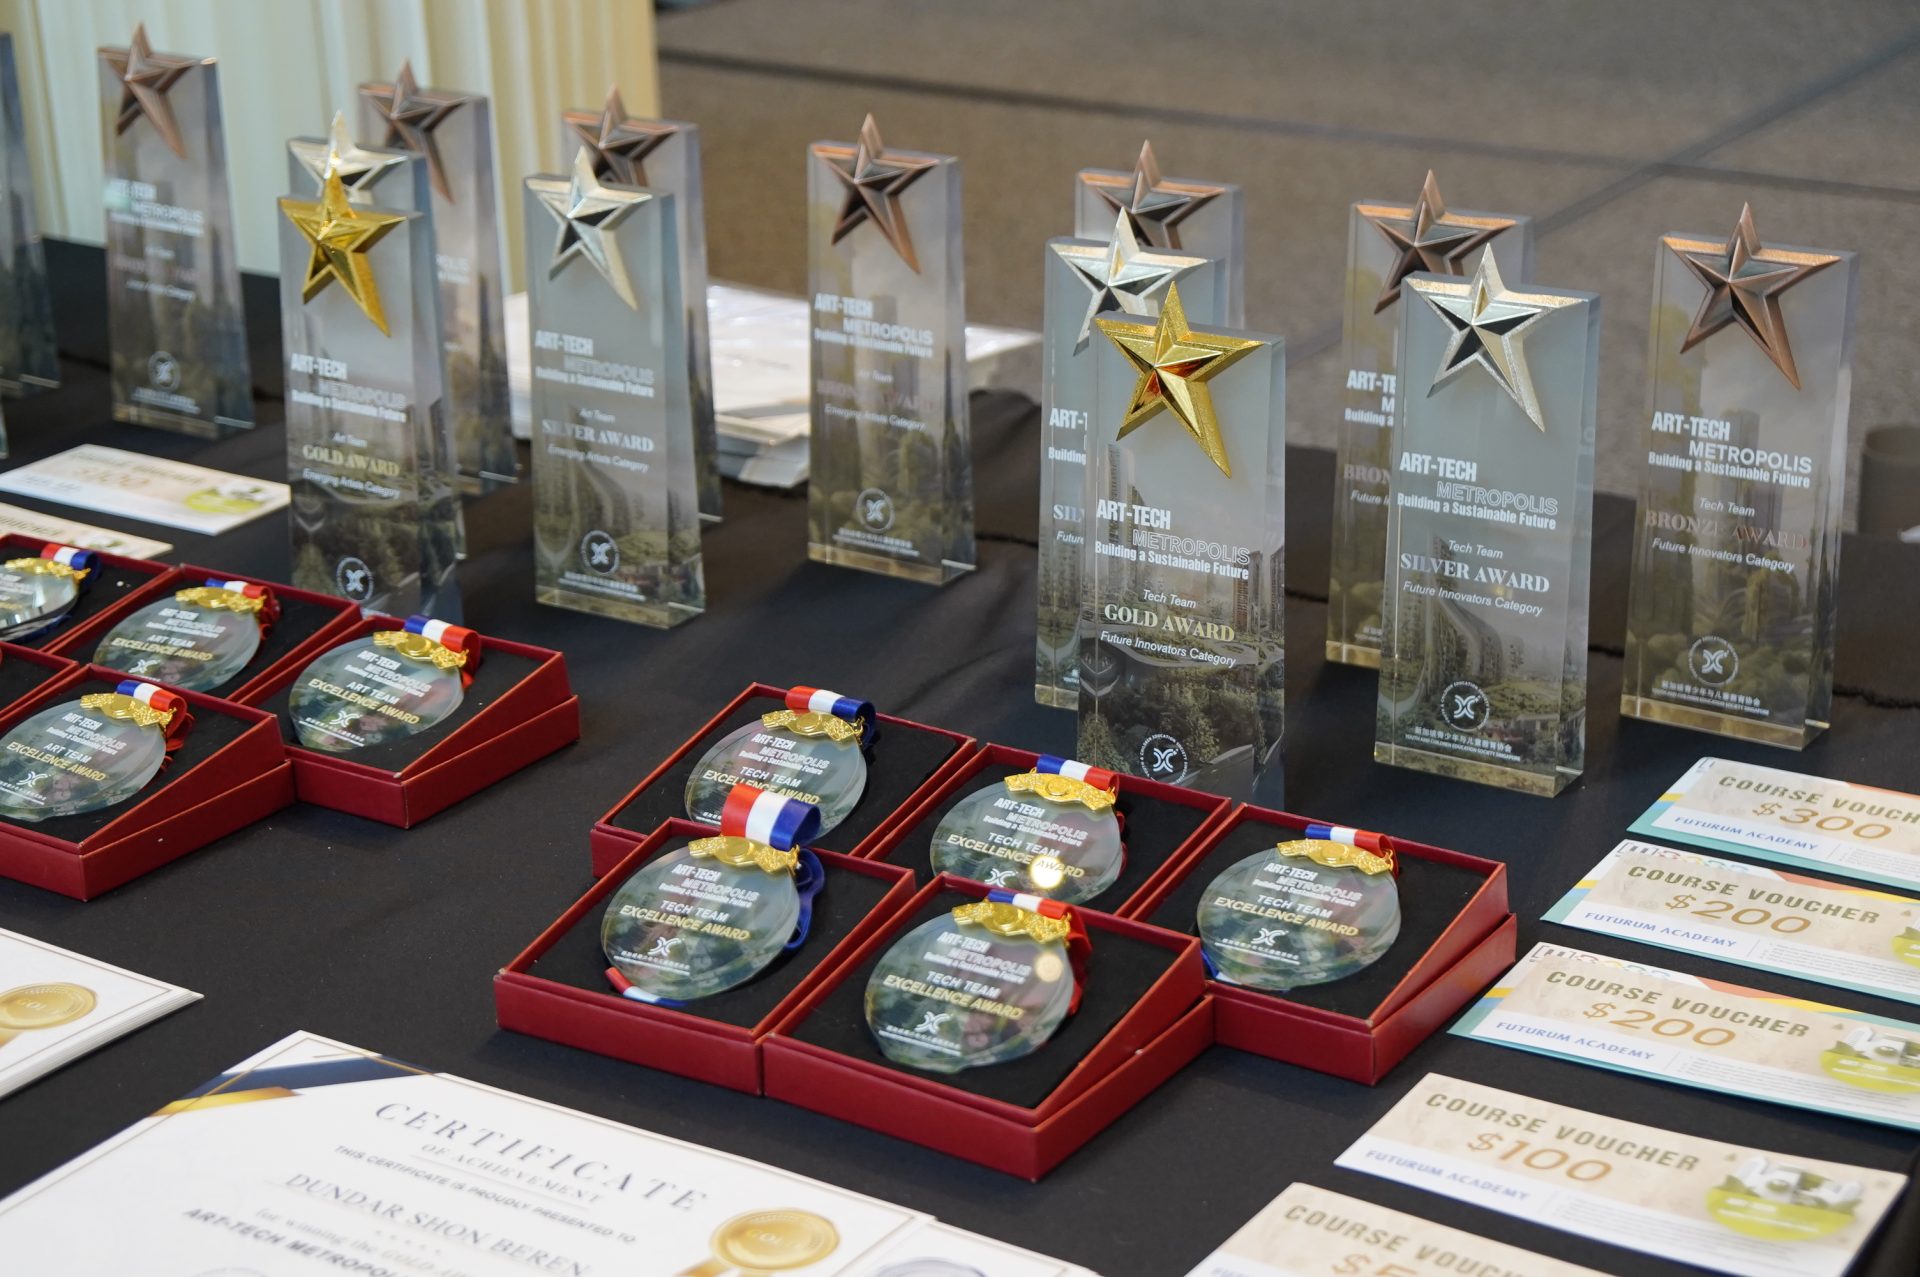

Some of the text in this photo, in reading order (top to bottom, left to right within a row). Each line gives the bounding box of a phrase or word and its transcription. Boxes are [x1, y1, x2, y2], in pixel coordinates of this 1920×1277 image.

[843, 318, 933, 345] METROPOLIS
[598, 430, 654, 451] AWARD
[1651, 411, 1730, 442] ART-TECH
[302, 444, 400, 476] GOLD AWARD
[1400, 452, 1477, 482] ART-TECH
[1648, 451, 1810, 488] Building a Sustainable Future
[1689, 440, 1812, 474] METROPOLIS
[1096, 499, 1171, 530] ART-TECH
[1397, 492, 1556, 530] Building a Sustainable Future
[1436, 481, 1558, 516] METROPOLIS
[1700, 497, 1756, 517] Tech Team
[1095, 540, 1249, 580] Building a Sustainable Future
[1133, 529, 1250, 565] METROPOLIS
[1448, 540, 1503, 559] Tech Team
[1652, 537, 1795, 574] Future Innovators Category
[1400, 552, 1550, 593] SILVER AWARD
[1143, 589, 1197, 609] Tech Team
[1403, 580, 1543, 617] Future Innovators Category
[1104, 604, 1235, 642] GOLD AWARD
[1101, 630, 1236, 668] Future Innovators Category
[308, 678, 420, 724] EXCELLENCE AWARD
[346, 682, 400, 704] ART TEAM
[44, 743, 92, 763] ART TEAM
[751, 733, 797, 750] ART-TECH
[760, 746, 830, 768] METROPOLIS
[6, 741, 107, 781] EXCELLENCE AWARD
[740, 766, 802, 788] TECH TEAM
[778, 786, 820, 805] AWARD
[994, 798, 1046, 817] ART-TECH
[1718, 775, 1920, 825] COURSE VOUCH
[1006, 812, 1088, 840] METROPOLIS
[1674, 816, 1819, 851] FUTURUM ACADEMY
[1752, 802, 1892, 840] $300
[947, 834, 1034, 864] EXCELLENCE
[988, 832, 1060, 858] TECH TEAM
[672, 864, 722, 882] ART-TECH
[682, 878, 760, 901] METROPOLIS
[1264, 863, 1318, 881] ART-TECH
[1276, 876, 1363, 901] METROPOLIS
[660, 900, 729, 922] TECH TEAM
[1257, 895, 1333, 918] TECH TEAM
[1627, 865, 1881, 925] COURSE VOUCHER
[620, 905, 750, 940] EXCELLENCE AWARD
[1214, 896, 1360, 936] EXCELLENCE AWARD
[1584, 911, 1738, 948] FUTURUM ACADEMY
[1664, 893, 1812, 934] $200
[937, 931, 992, 953] ART-TECH
[948, 948, 1032, 976] METROPOLIS
[883, 974, 1025, 1020] EXCELLENCE AWARD
[926, 971, 1001, 998] TECH TEAM
[1546, 970, 1811, 1037] COURSE VOUCHER
[1496, 1021, 1656, 1060] FUTURUM ACADEMY
[1582, 1002, 1737, 1047] $200
[1425, 1092, 1701, 1172] COURSE VOUCHER
[374, 1102, 709, 1213] CERTIFICATE
[1466, 1131, 1613, 1183] $100
[1366, 1149, 1532, 1201] FUTURUM ACADEMY
[367, 1154, 449, 1186] CERTIFICATE
[467, 1186, 530, 1211] PROUDLY
[532, 1205, 615, 1236] PRESENTED
[182, 1208, 287, 1245] ART-TECH
[284, 1172, 593, 1277] DUNDAR SHON BEREN
[1284, 1204, 1409, 1252] COURSE
